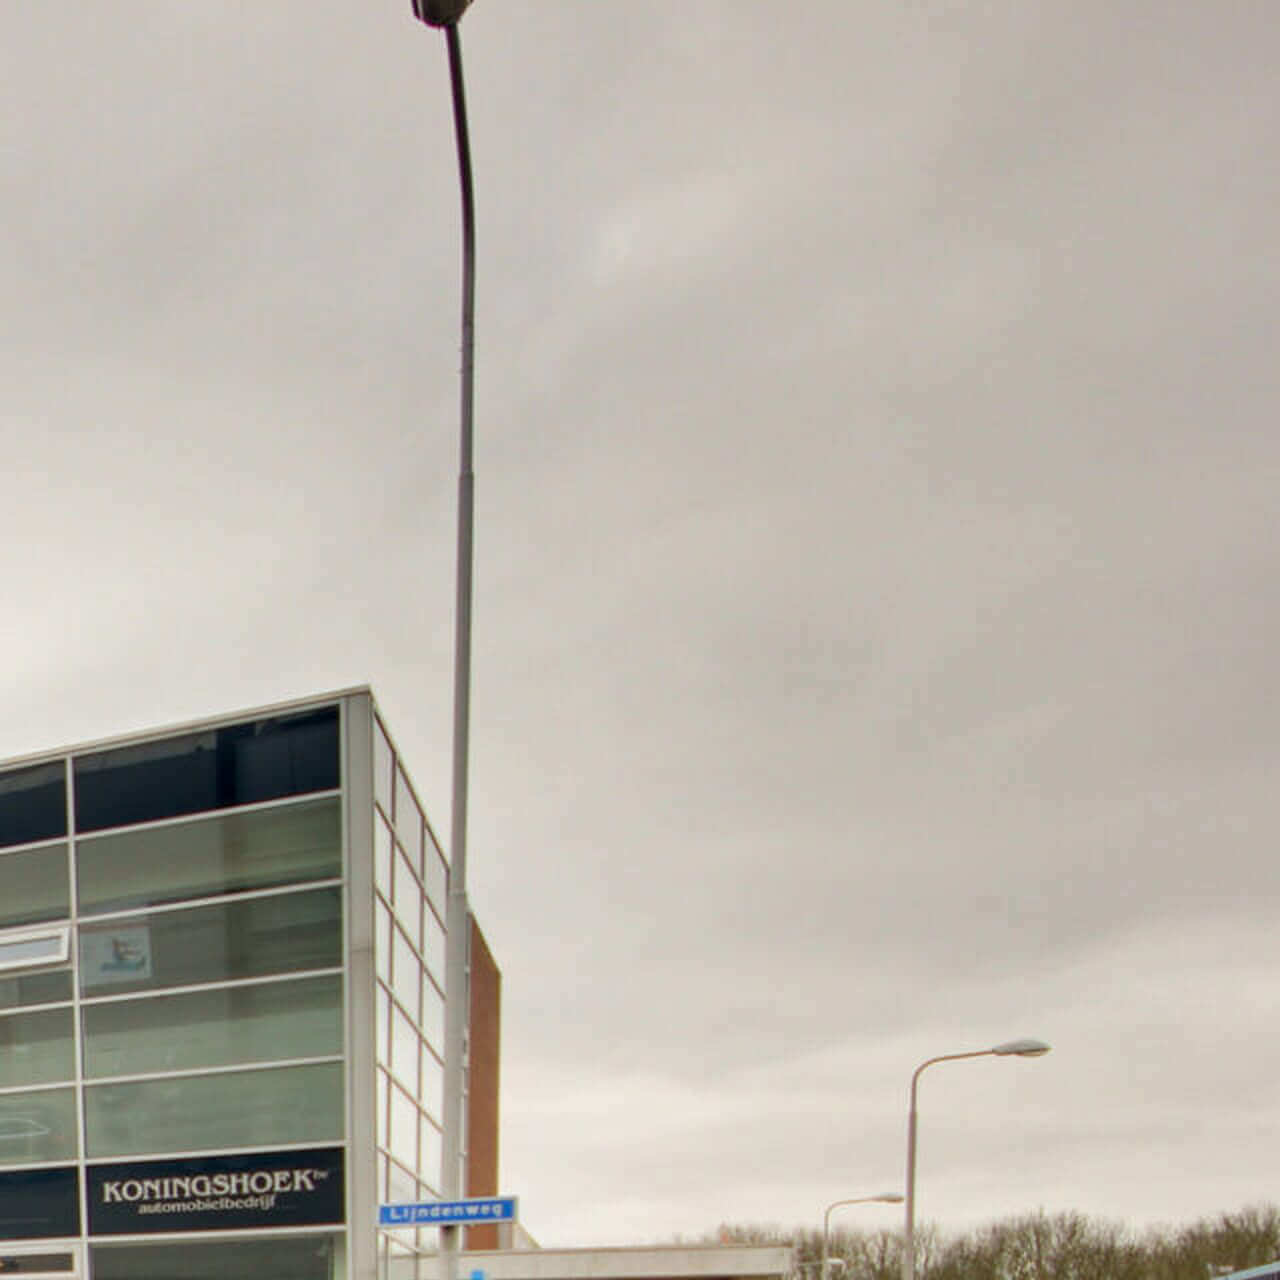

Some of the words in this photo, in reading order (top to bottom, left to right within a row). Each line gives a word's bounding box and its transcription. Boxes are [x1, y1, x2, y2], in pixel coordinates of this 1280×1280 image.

[103, 1169, 315, 1203] KONINGSHOEK
[138, 1195, 276, 1215] automobielbedrijf
[389, 1203, 503, 1222] Lijndenweg
